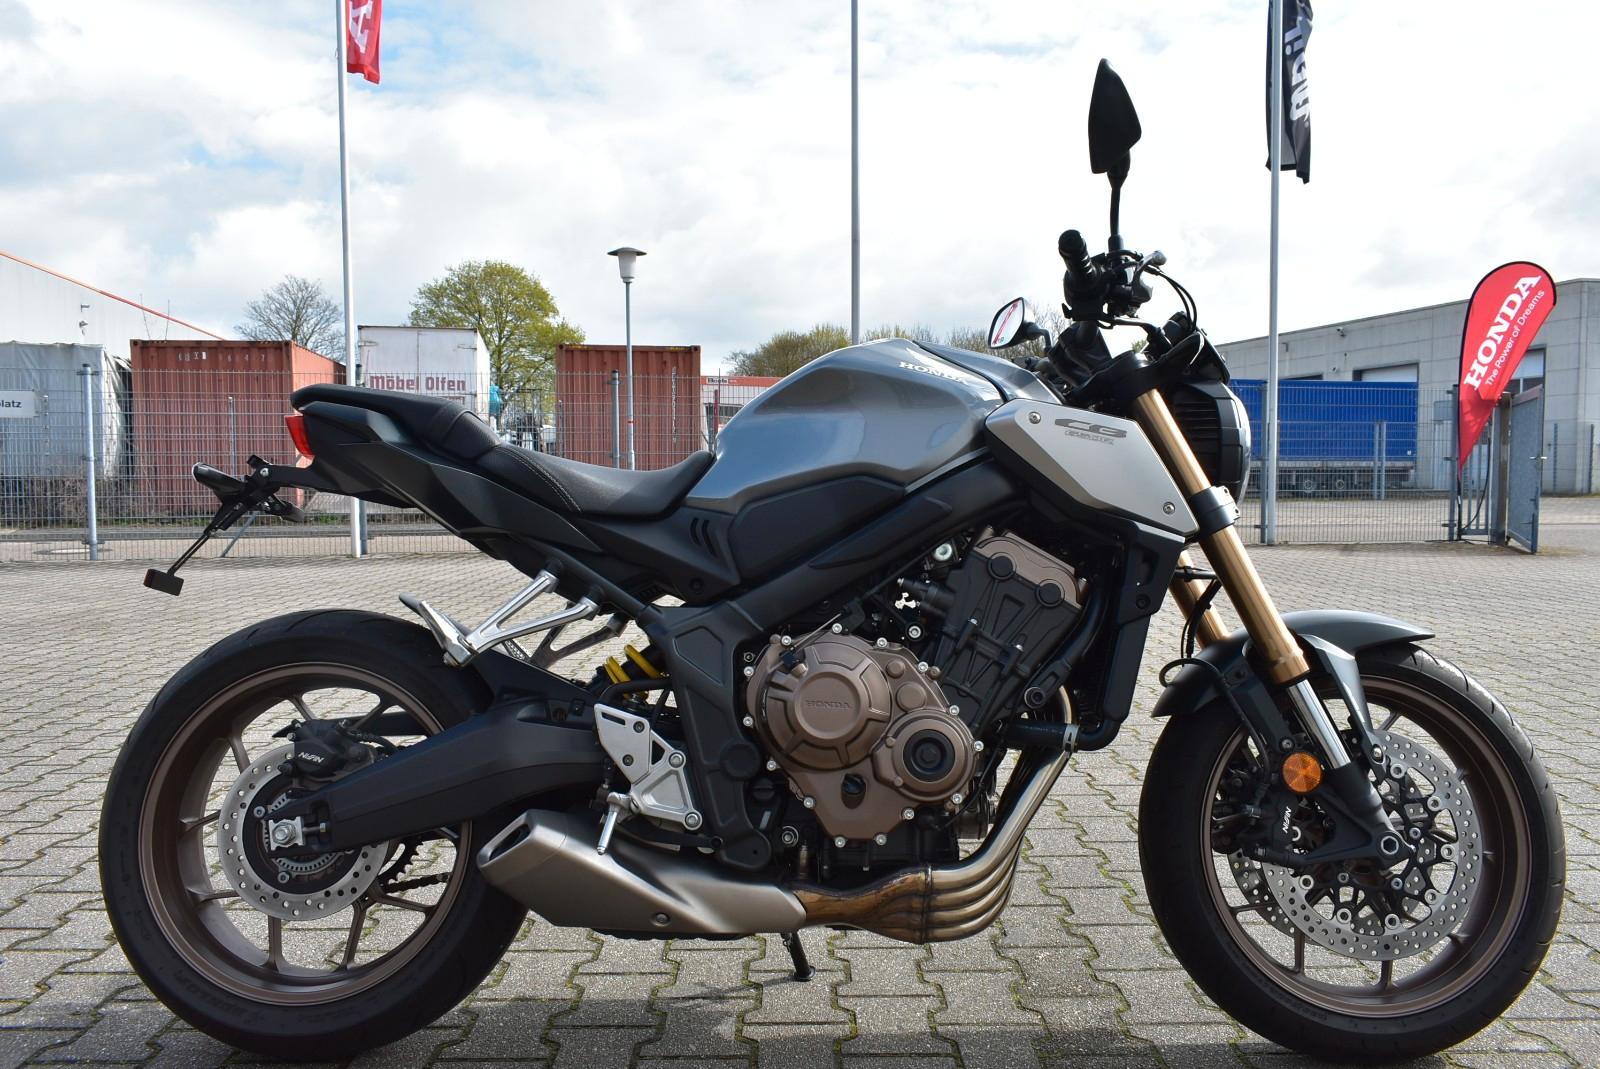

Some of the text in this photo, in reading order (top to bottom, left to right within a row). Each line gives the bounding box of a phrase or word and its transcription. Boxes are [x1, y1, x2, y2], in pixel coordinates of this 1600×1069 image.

[1463, 275, 1542, 391] HONDA
[1486, 368, 1499, 386] The
[1494, 338, 1515, 369] Power
[1517, 290, 1545, 326] Dreams
[369, 375, 466, 392] Möbel Olfen
[898, 360, 970, 387] HONDA
[0, 399, 22, 409] latz
[805, 699, 851, 710] HONDA
